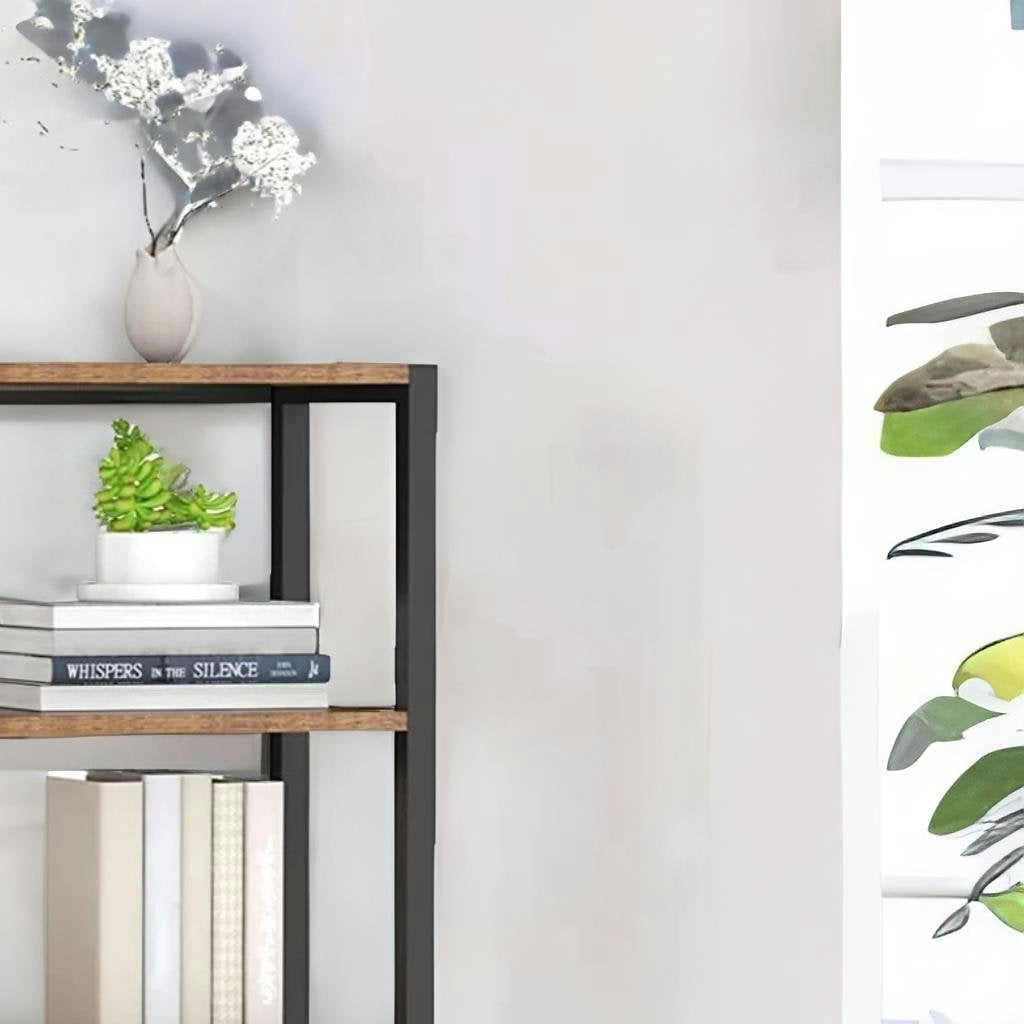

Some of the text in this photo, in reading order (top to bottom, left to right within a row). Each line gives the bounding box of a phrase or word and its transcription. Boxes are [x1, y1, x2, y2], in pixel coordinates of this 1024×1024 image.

[66, 663, 143, 679] WHISPERS
[151, 667, 163, 679] IN
[166, 667, 186, 678] THE
[193, 662, 258, 678] SILENCE
